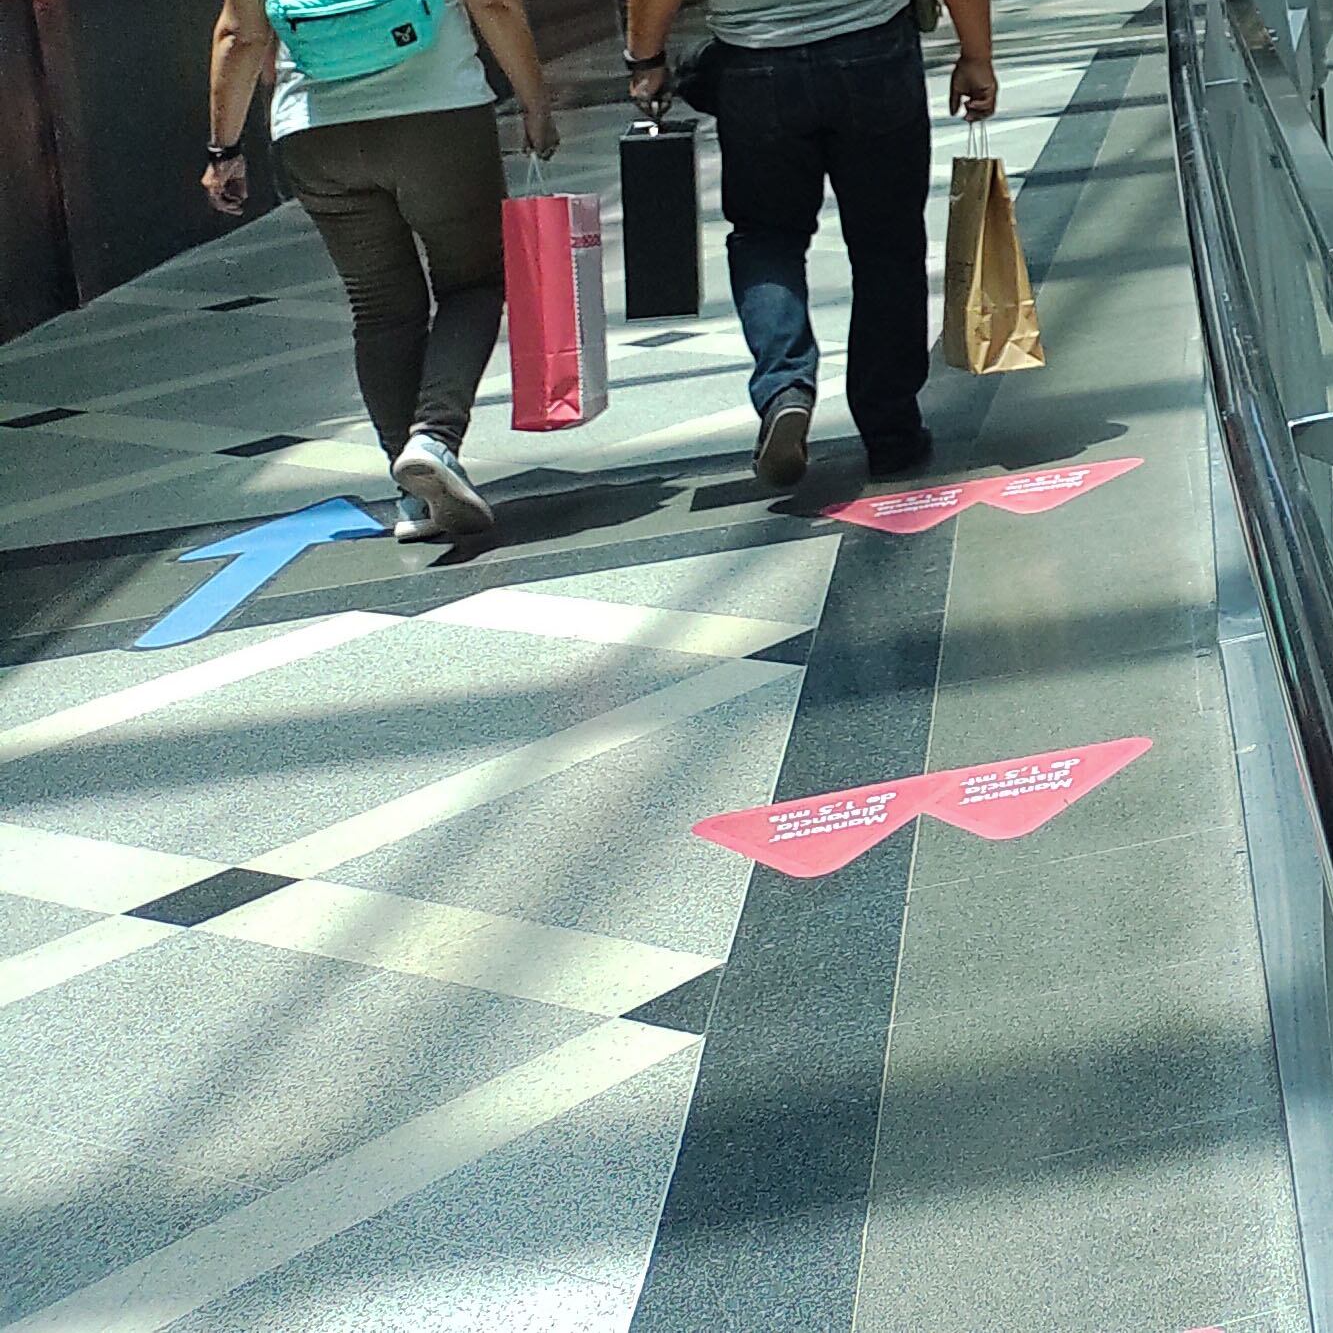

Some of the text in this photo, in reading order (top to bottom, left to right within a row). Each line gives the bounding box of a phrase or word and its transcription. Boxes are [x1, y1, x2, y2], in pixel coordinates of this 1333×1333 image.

[1051, 757, 1081, 770] de
[958, 778, 1073, 805] Mantener
[965, 770, 1070, 796] distancia
[818, 799, 855, 816] 1,5
[866, 791, 897, 804] de
[768, 813, 888, 843] Mantener
[776, 803, 885, 832] distancia
